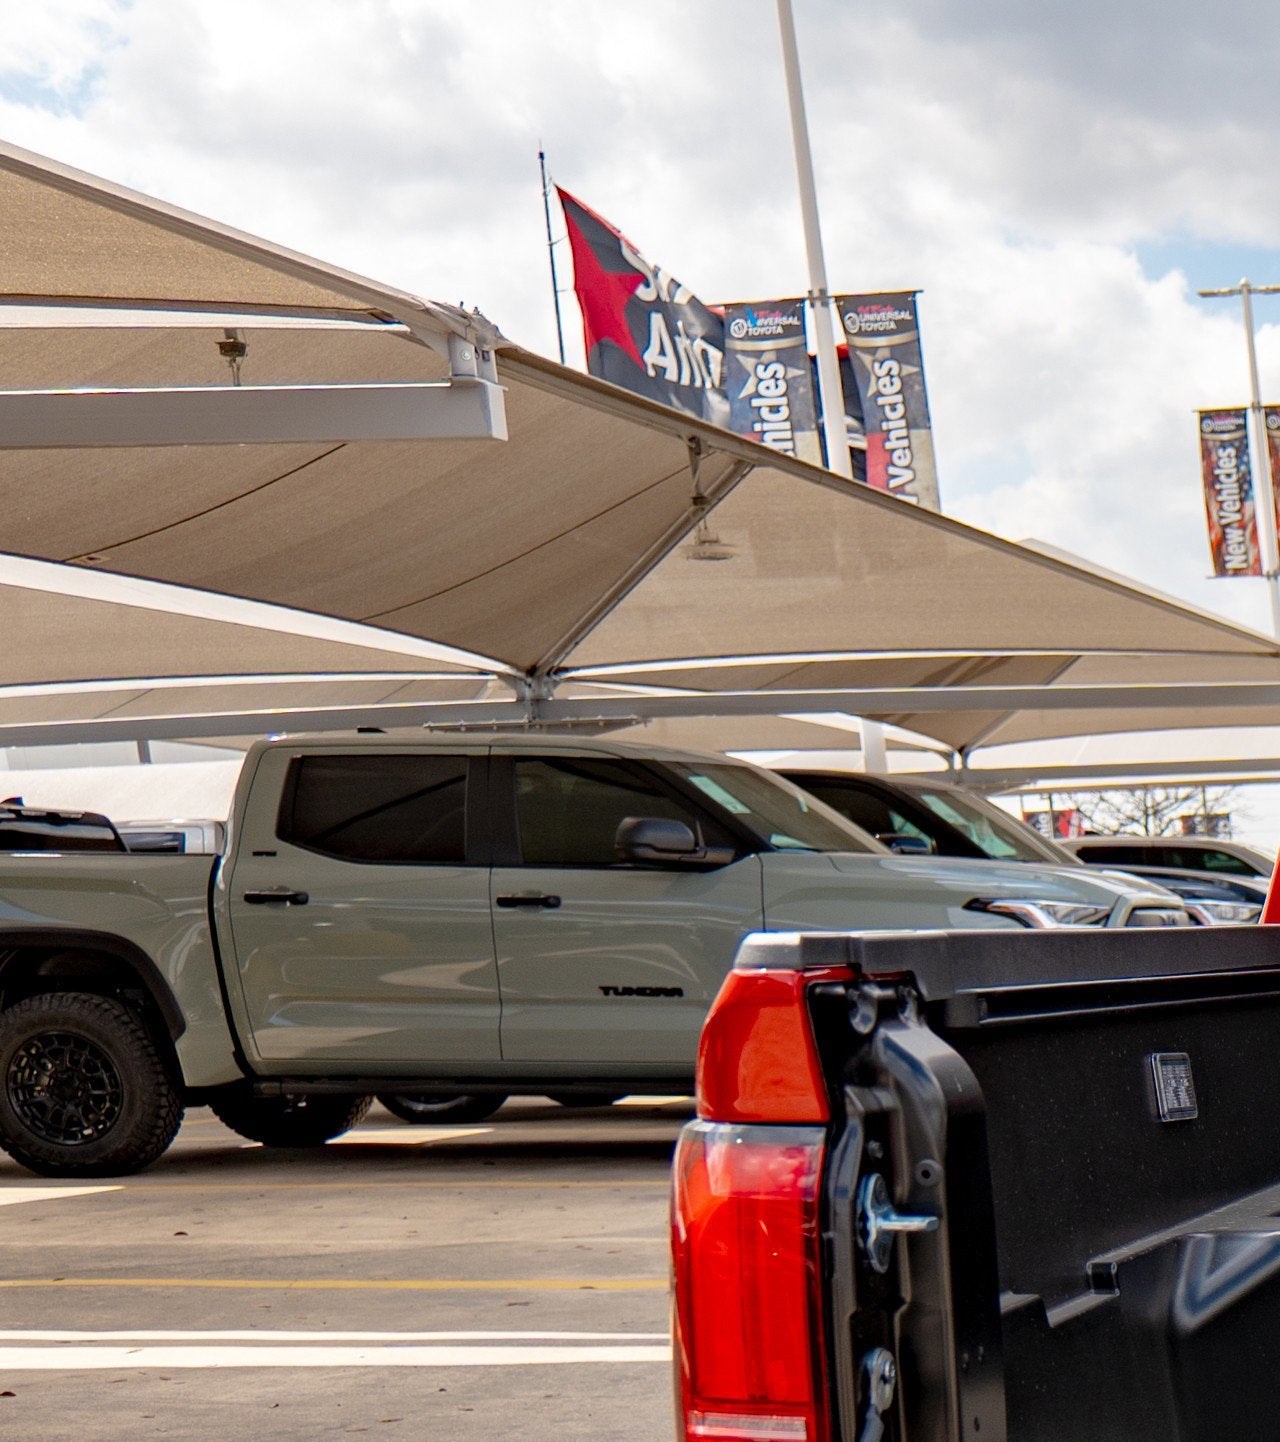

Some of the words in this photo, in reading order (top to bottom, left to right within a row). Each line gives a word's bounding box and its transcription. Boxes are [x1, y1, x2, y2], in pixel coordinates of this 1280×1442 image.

[748, 325, 785, 337] TOYOTA
[860, 320, 897, 332] TOYOTA
[872, 357, 916, 490] Vehicles
[1212, 445, 1243, 526] Vehicles
[1223, 526, 1249, 570] New
